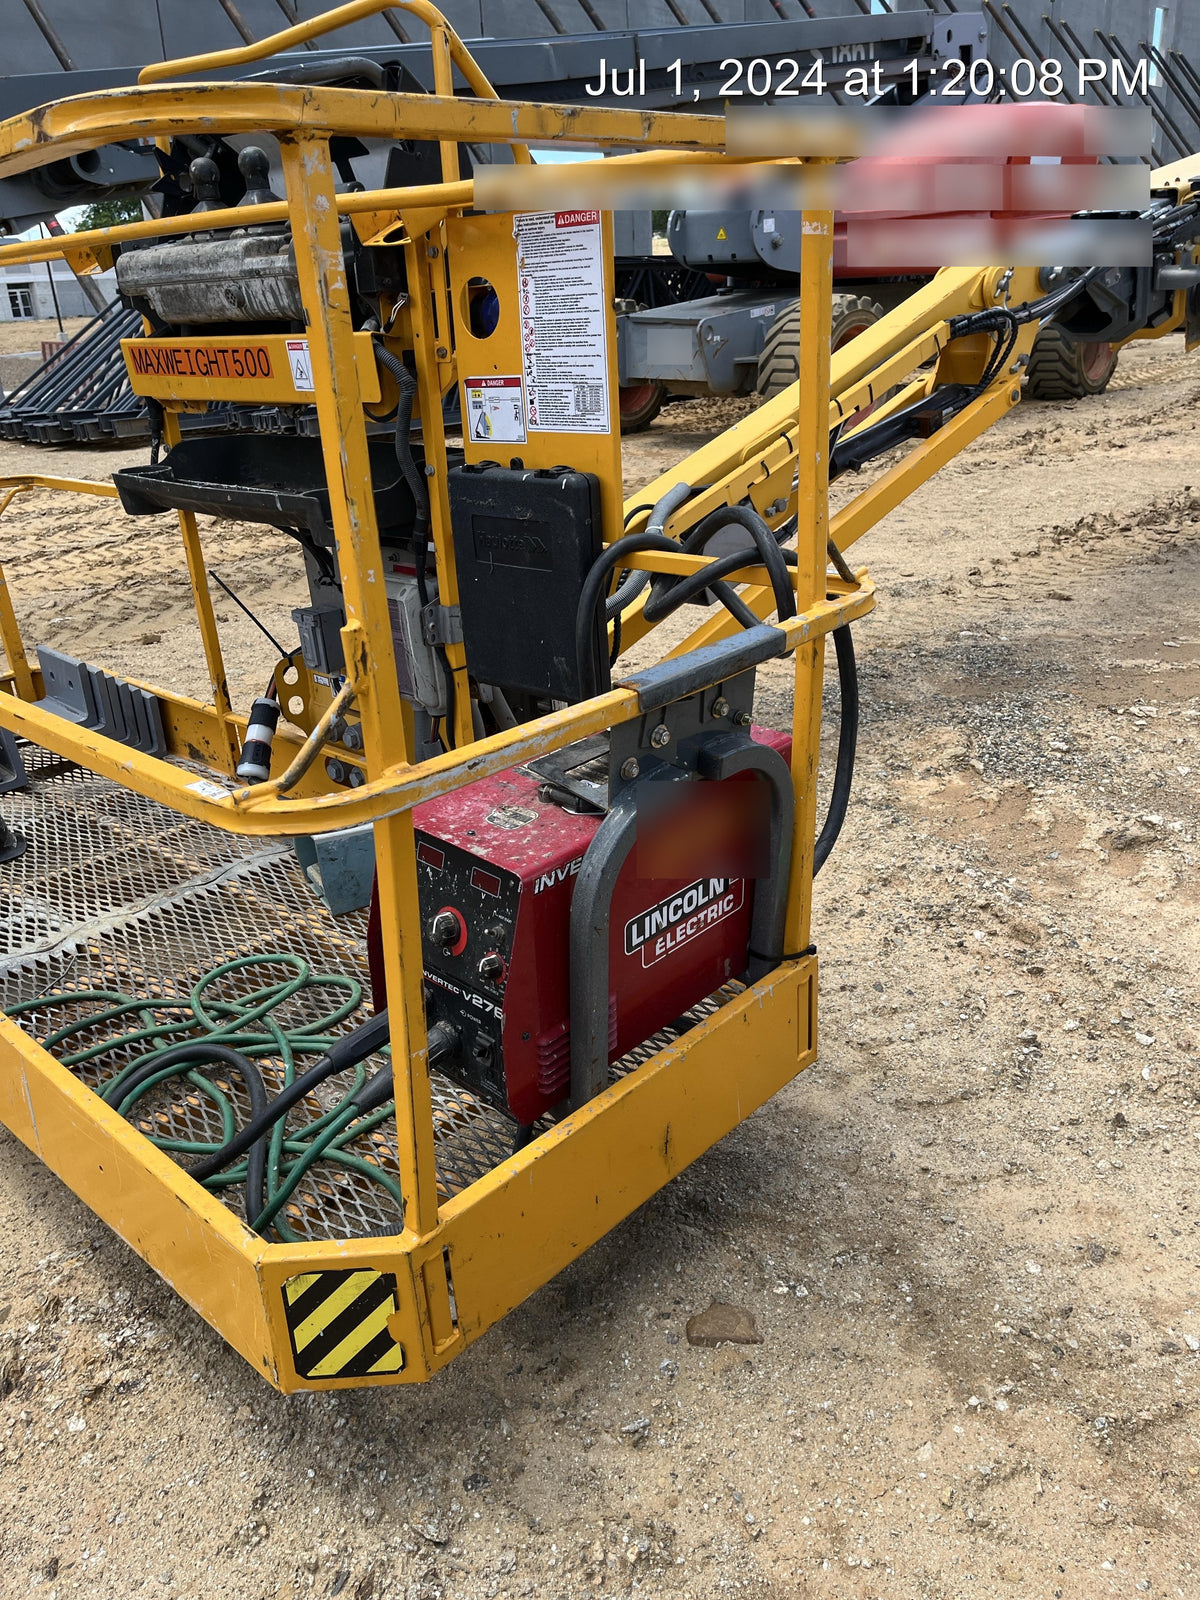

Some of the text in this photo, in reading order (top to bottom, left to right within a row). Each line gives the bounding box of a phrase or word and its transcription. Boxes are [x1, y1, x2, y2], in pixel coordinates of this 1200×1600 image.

[564, 211, 597, 224] DANGER
[130, 347, 271, 377] MAXWEIGHT500
[534, 857, 583, 894] INVE
[631, 878, 724, 947] LINCOLN
[656, 894, 734, 956] ELECTRIC
[422, 970, 459, 994] NVERTEC
